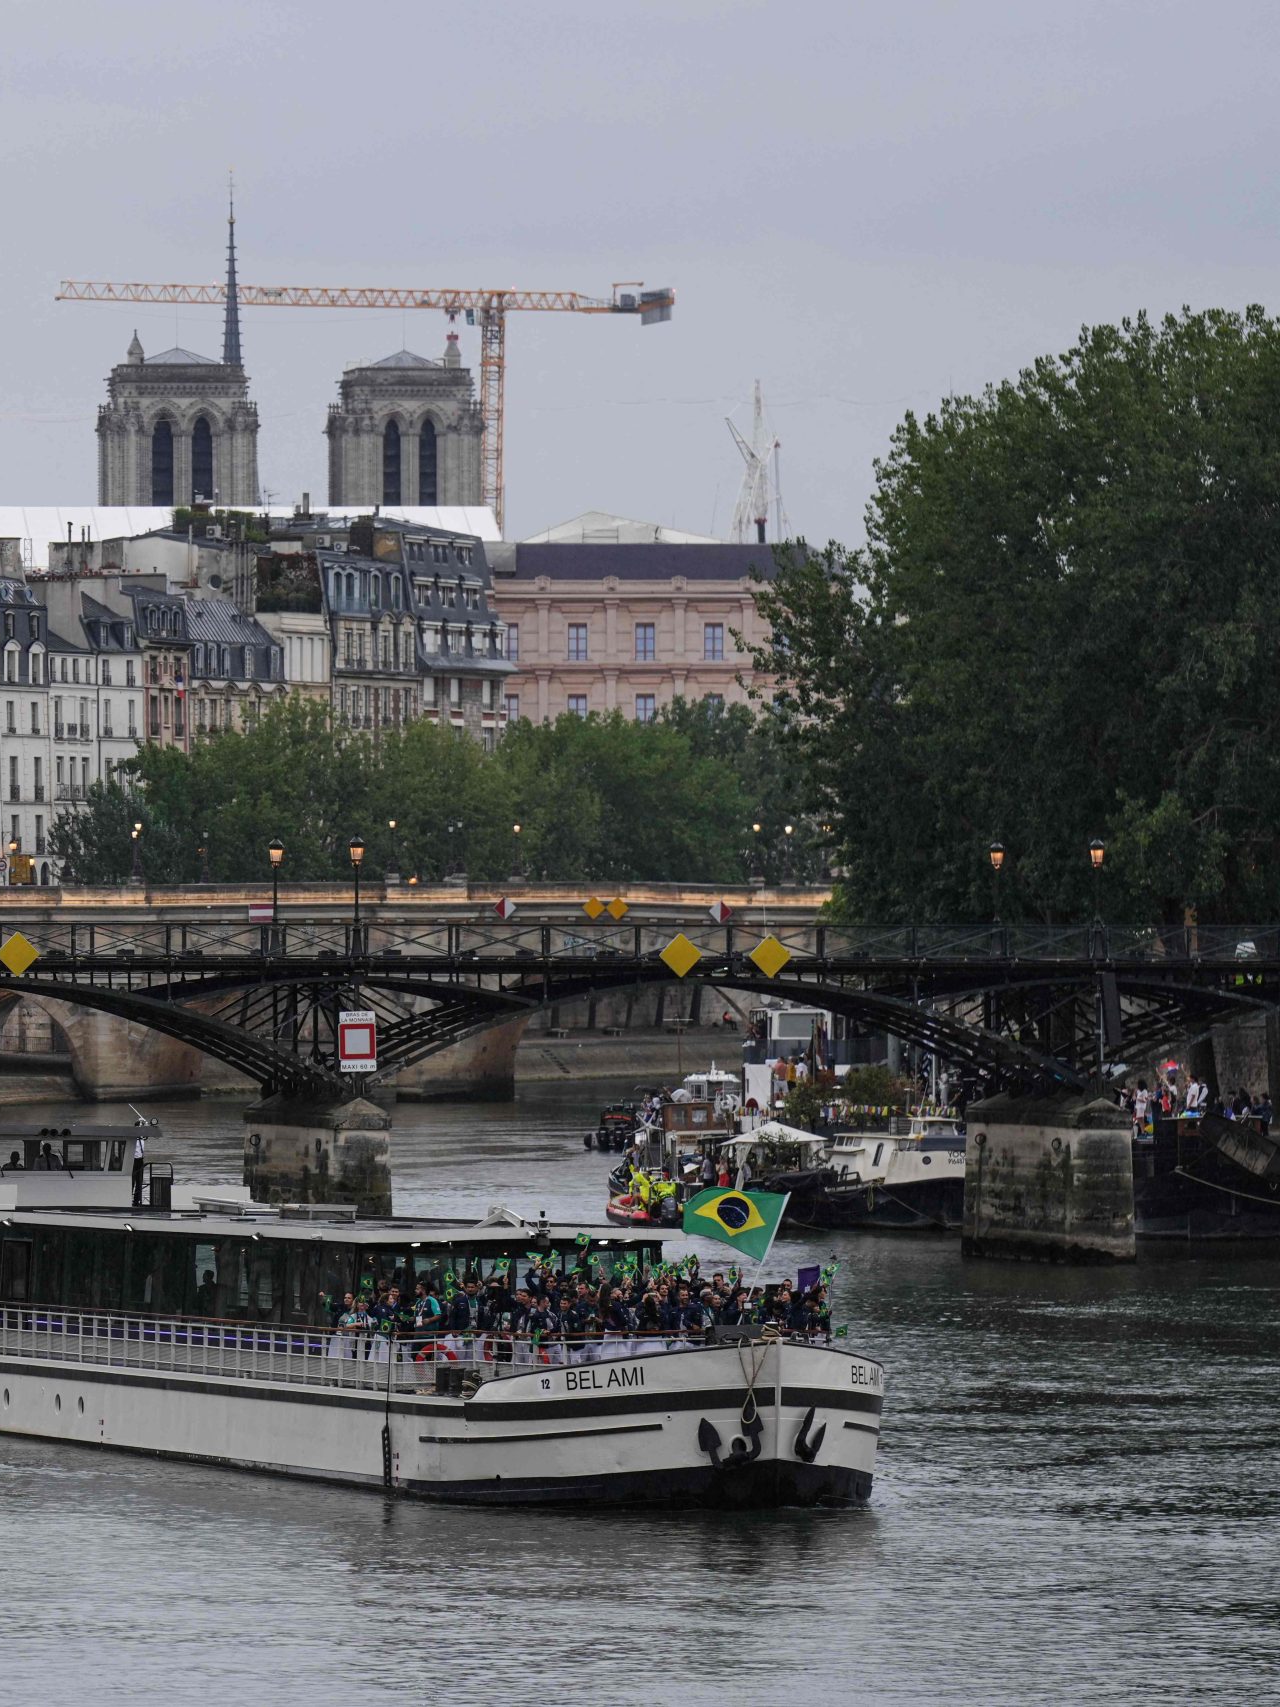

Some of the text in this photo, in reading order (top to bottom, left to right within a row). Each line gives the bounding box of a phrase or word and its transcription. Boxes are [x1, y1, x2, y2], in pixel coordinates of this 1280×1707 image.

[541, 1366, 645, 1391] 12 BEL AMI
[852, 1365, 868, 1385] BEL
